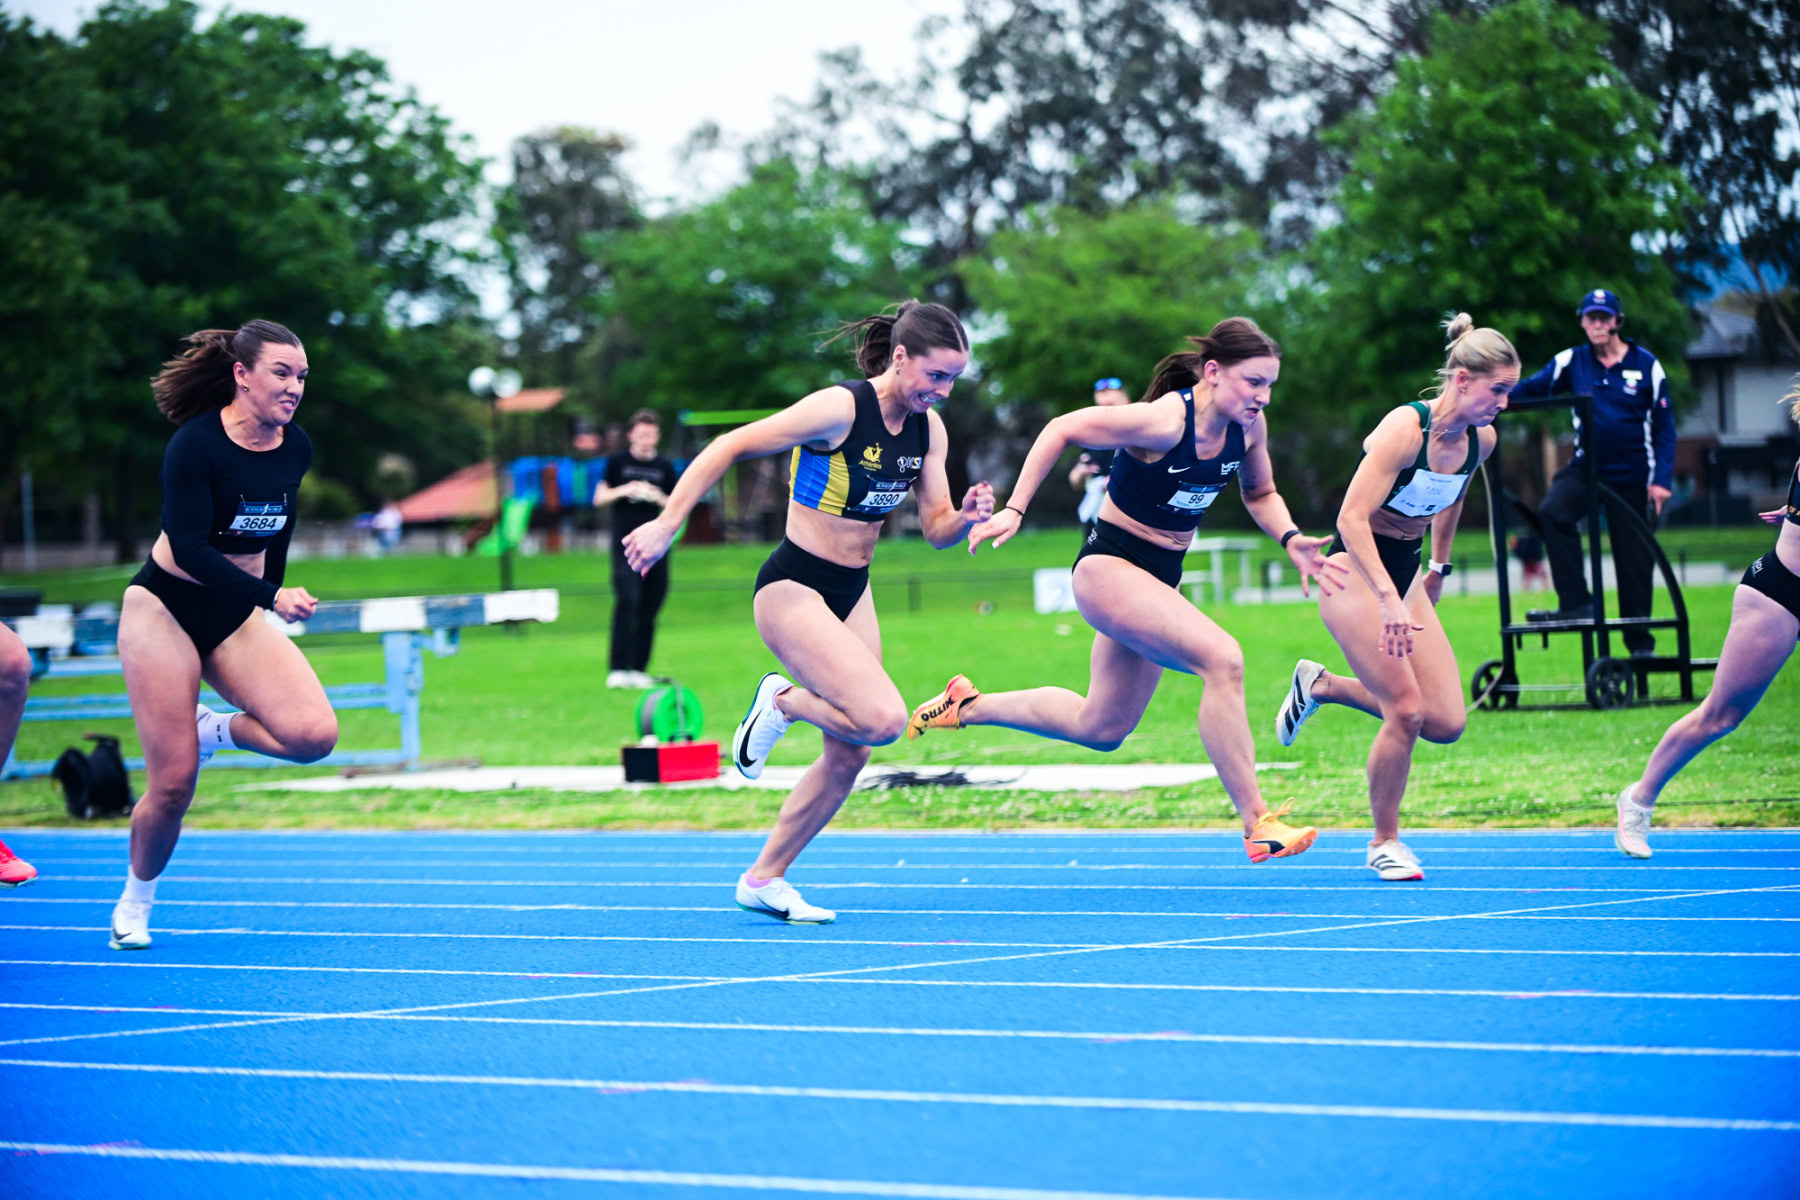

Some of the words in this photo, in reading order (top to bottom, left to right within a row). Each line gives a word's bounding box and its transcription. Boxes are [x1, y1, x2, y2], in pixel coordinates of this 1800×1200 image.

[869, 493, 900, 505] 3890
[1188, 494, 1205, 504] 99
[240, 517, 277, 529] 3684
[921, 694, 957, 722] NITRO
